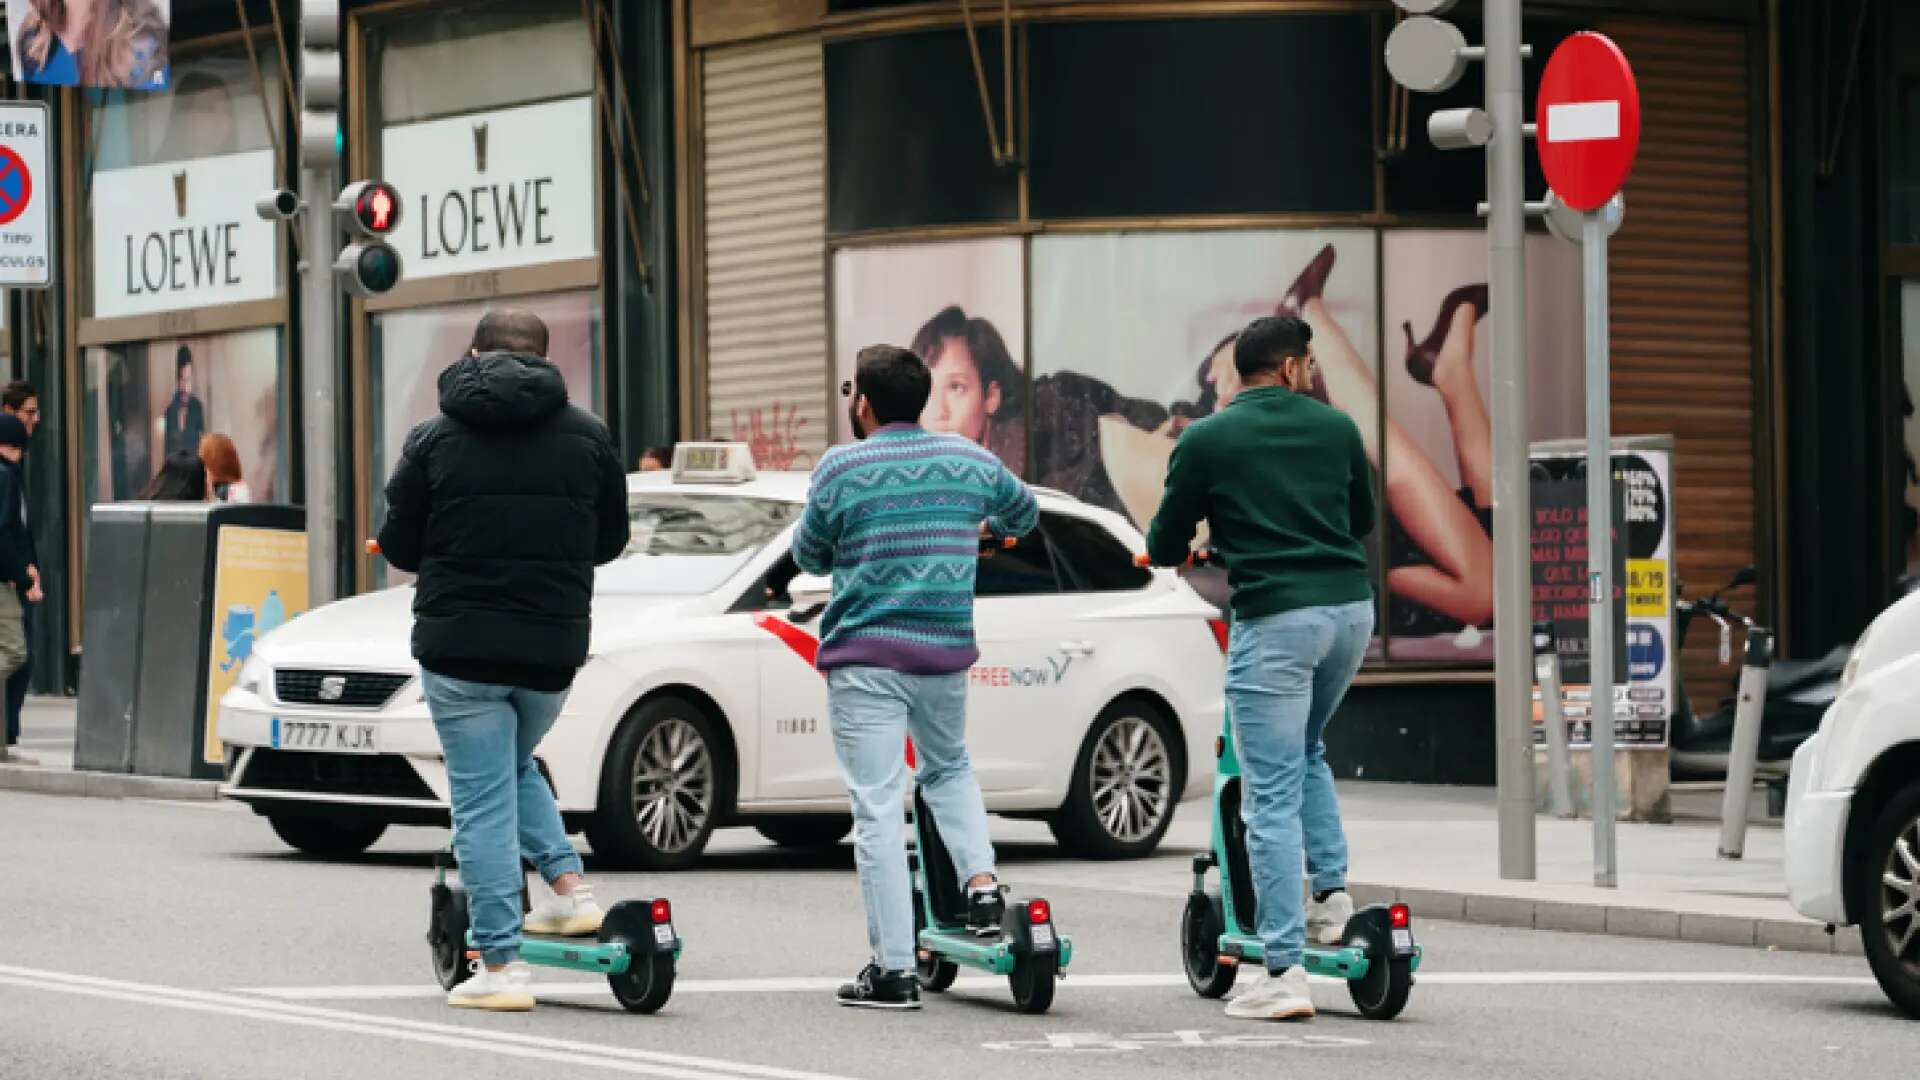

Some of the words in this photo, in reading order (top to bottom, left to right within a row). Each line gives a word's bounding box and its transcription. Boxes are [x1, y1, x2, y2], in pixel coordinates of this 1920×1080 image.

[420, 176, 554, 259] LOEWE
[125, 221, 241, 295] LOEWE
[970, 665, 1048, 687] FREENOW
[283, 722, 331, 747] 7777
[336, 724, 375, 749] KJX
